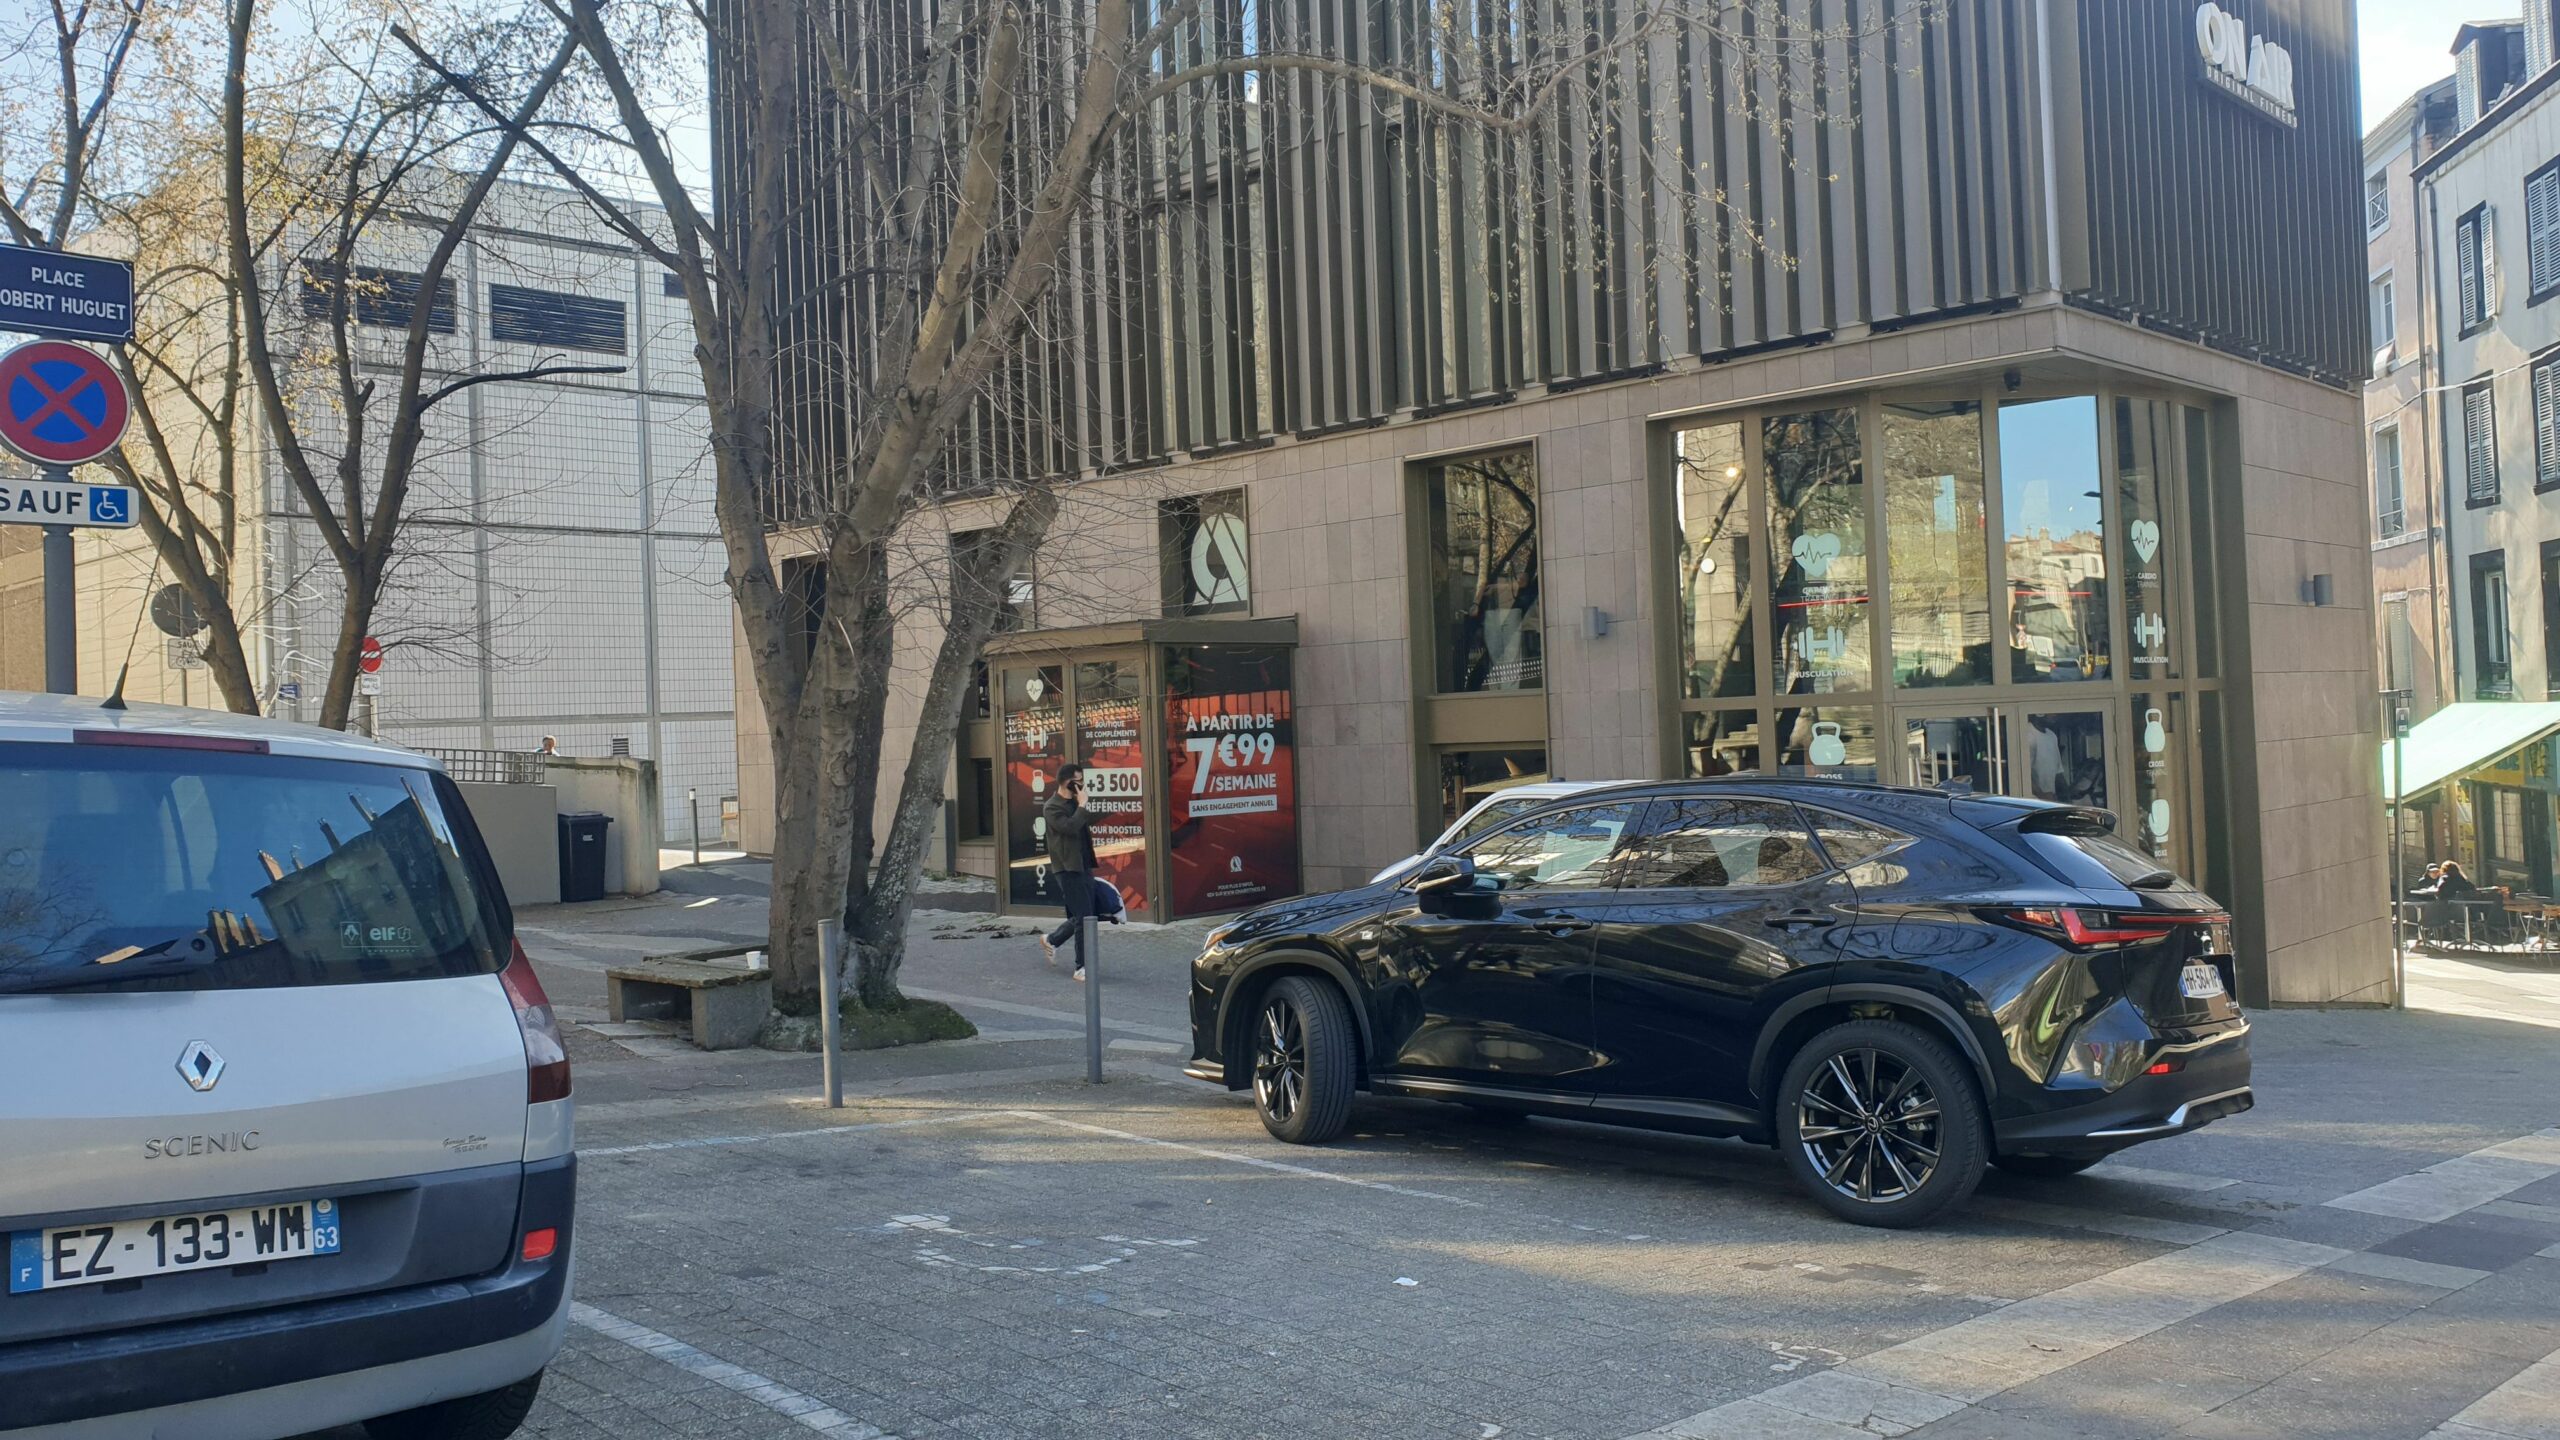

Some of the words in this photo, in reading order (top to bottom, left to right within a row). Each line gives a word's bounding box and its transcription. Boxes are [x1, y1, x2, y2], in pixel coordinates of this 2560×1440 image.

[2196, 2, 2247, 82] ON
[2207, 65, 2254, 103] ORIGINAL
[2259, 97, 2298, 128] FITNESS
[31, 266, 85, 289] PLACE
[61, 296, 126, 320] HUGUET
[0, 487, 83, 514] SAUF
[2137, 572, 2157, 580] CARDIO
[2133, 656, 2169, 664] MUSCULATION
[1186, 711, 1198, 732] À
[1201, 714, 1253, 731] PARTIR
[1256, 713, 1275, 729] DE
[1085, 731, 1094, 739] DE
[1186, 732, 1276, 794] 7€99
[1087, 774, 1105, 792] +3
[1109, 773, 1140, 792] 500
[1209, 773, 1277, 793] /SEMAINE
[1086, 799, 1142, 813] RÉFÉRENCES
[1192, 804, 1209, 812] SANS
[1210, 801, 1249, 811] ENGAGEMENT
[1251, 799, 1274, 808] ANNUEL
[1109, 825, 1142, 834] BOOSTER
[370, 927, 395, 940] elf
[144, 1130, 260, 1159] SCENIC
[21, 1267, 32, 1283] F
[52, 1205, 305, 1281] EZ-133-WM
[314, 1226, 338, 1249] 63
